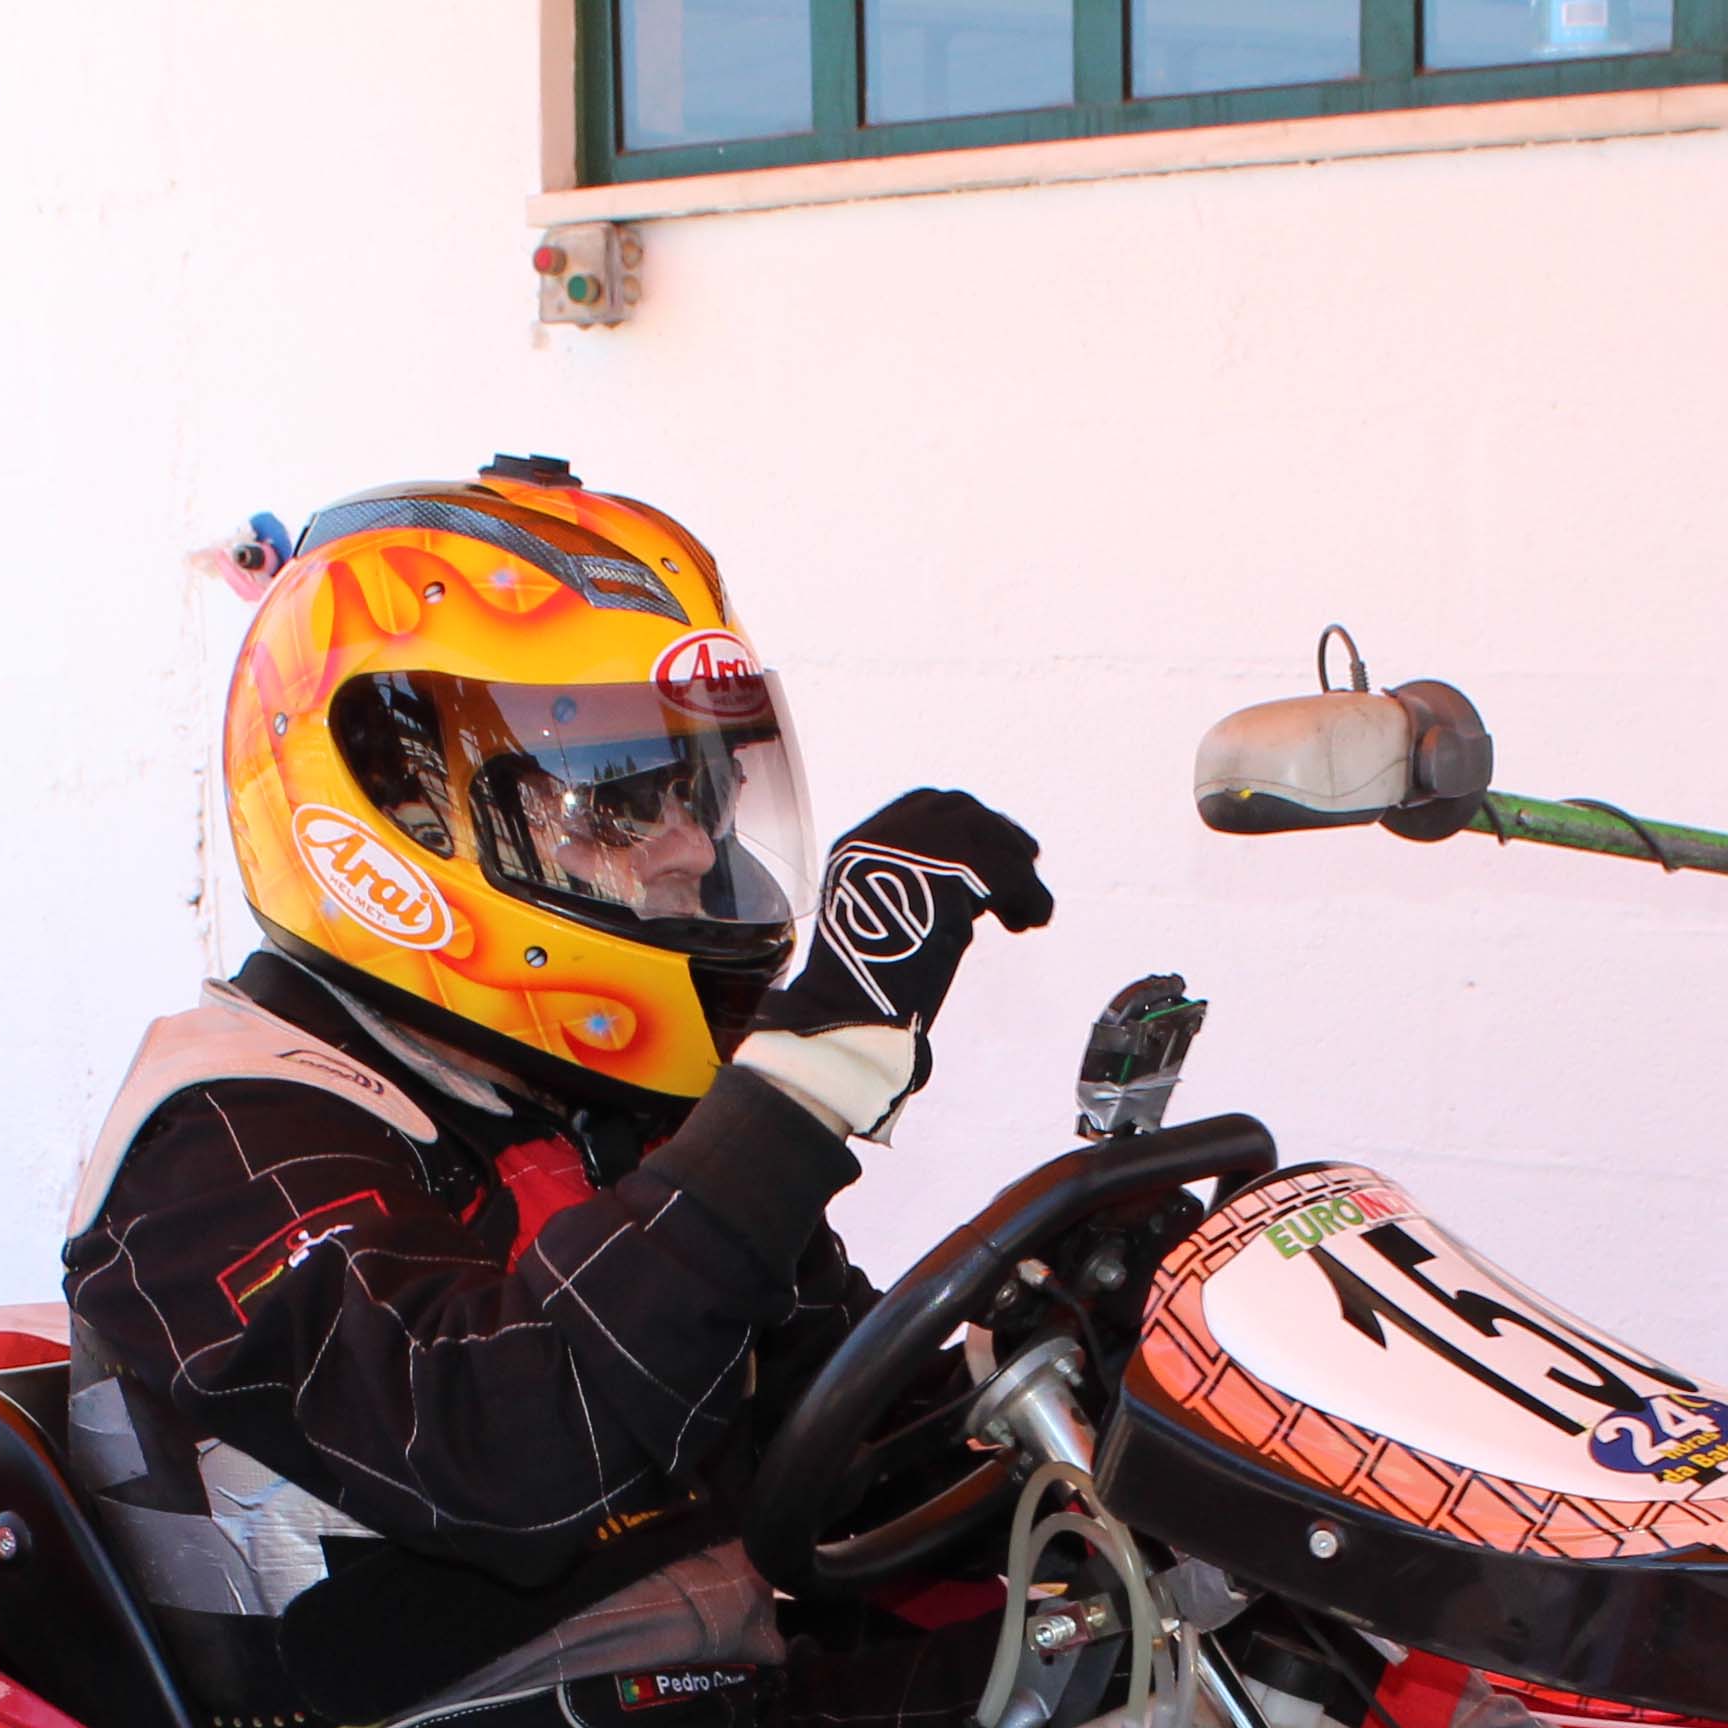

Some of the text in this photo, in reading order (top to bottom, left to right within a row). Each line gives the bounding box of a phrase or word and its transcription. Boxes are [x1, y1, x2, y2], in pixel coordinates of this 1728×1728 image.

[301, 832, 432, 927] Arai
[1594, 1396, 1721, 1466] 24
[1663, 1464, 1699, 1484] da
[656, 1672, 710, 1695] Pedro
